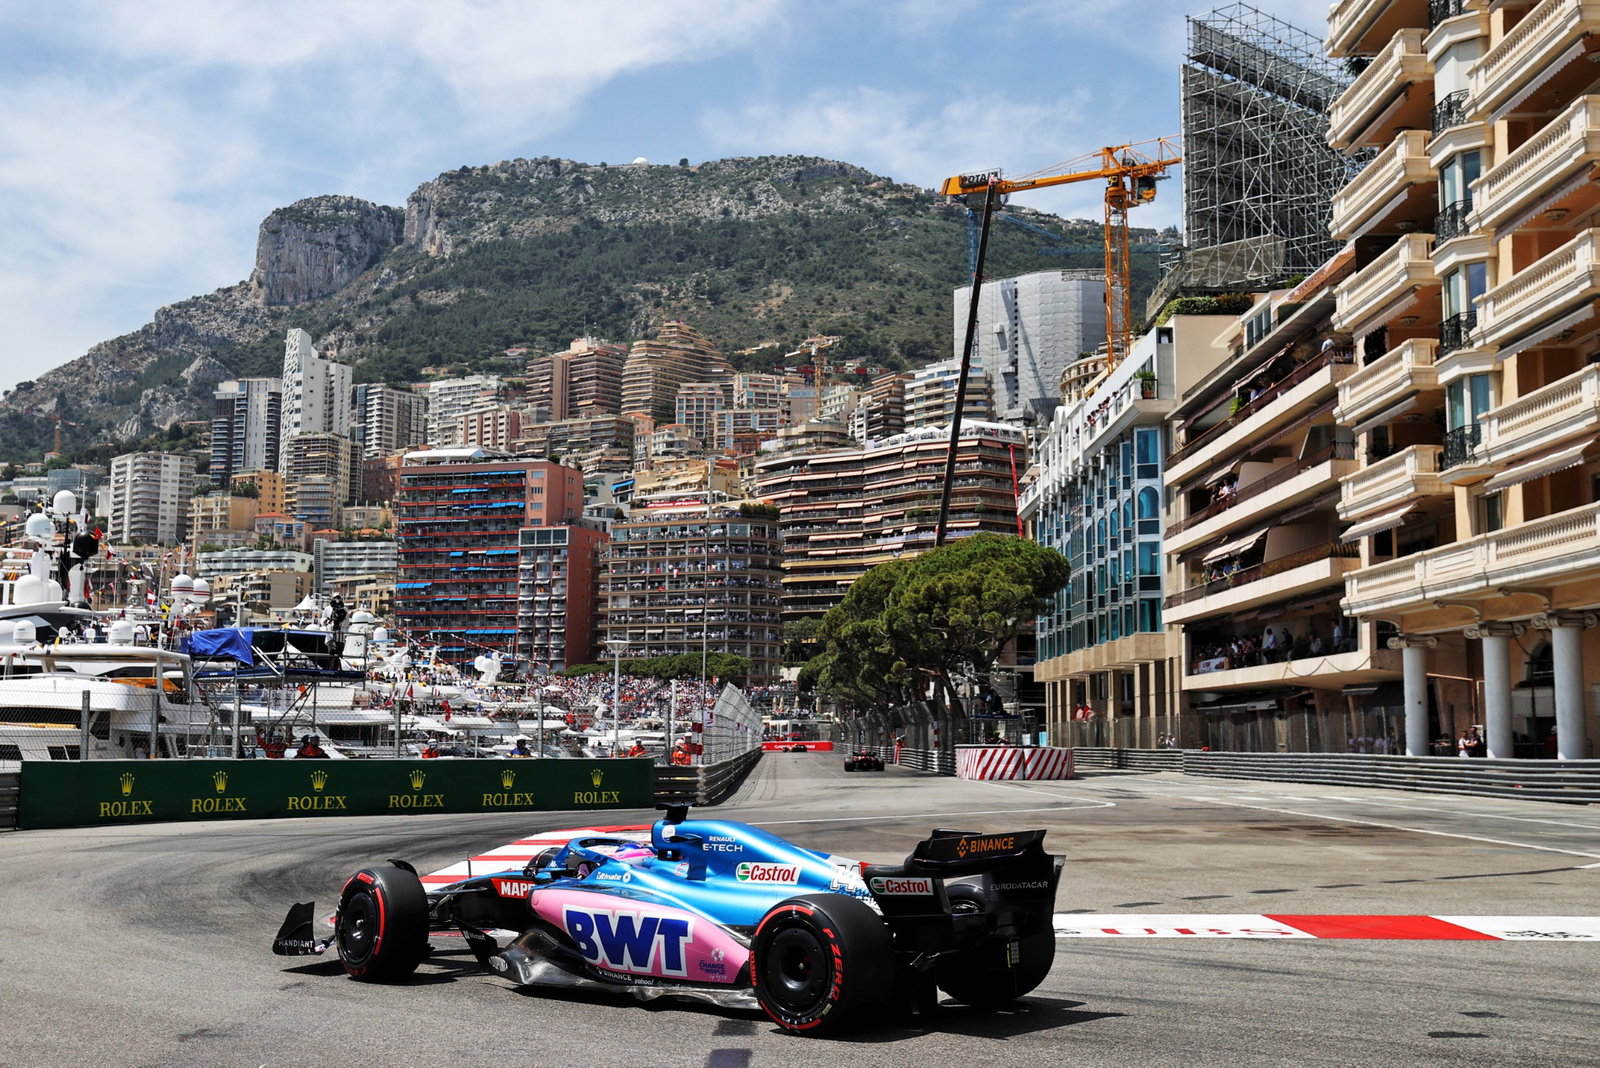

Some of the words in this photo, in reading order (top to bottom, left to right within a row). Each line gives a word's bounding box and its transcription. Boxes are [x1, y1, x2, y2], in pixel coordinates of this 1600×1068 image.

[191, 797, 247, 813] ROLEX
[287, 796, 347, 811] ROLEX
[388, 794, 445, 808] ROLEX
[482, 792, 535, 806] ROLEX
[574, 791, 620, 804] ROLEX
[99, 801, 153, 817] ROLEX
[970, 837, 1015, 853] BINANCE
[750, 864, 798, 882] Castrol
[885, 879, 930, 893] Castrol
[990, 881, 1048, 891] EURODATACAR
[278, 940, 314, 948] MANDIANT
[565, 909, 689, 972] BWT
[822, 928, 835, 939] P
[831, 944, 843, 1000] ZERO
